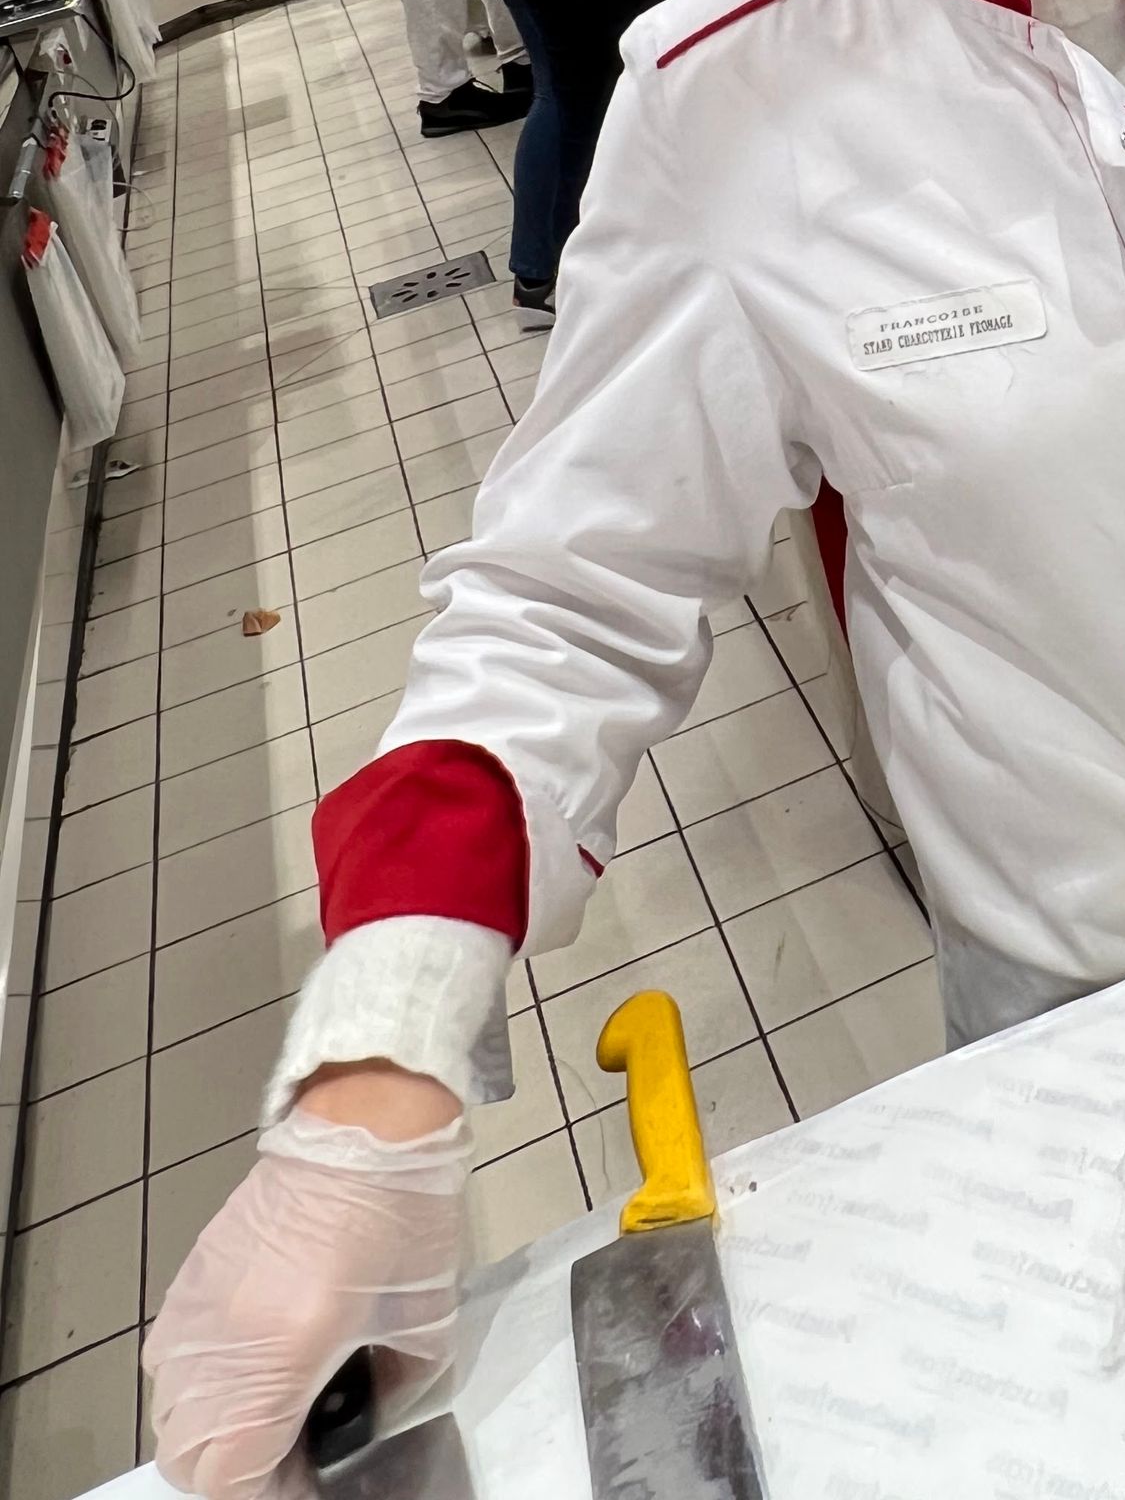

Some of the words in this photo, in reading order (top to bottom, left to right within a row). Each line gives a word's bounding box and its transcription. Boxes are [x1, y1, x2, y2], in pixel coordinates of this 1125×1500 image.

[863, 337, 893, 356] STAND
[898, 325, 966, 350] CHARCUTERIE
[970, 313, 1014, 336] FROMAGE
[880, 305, 984, 333] FRANCOISE
